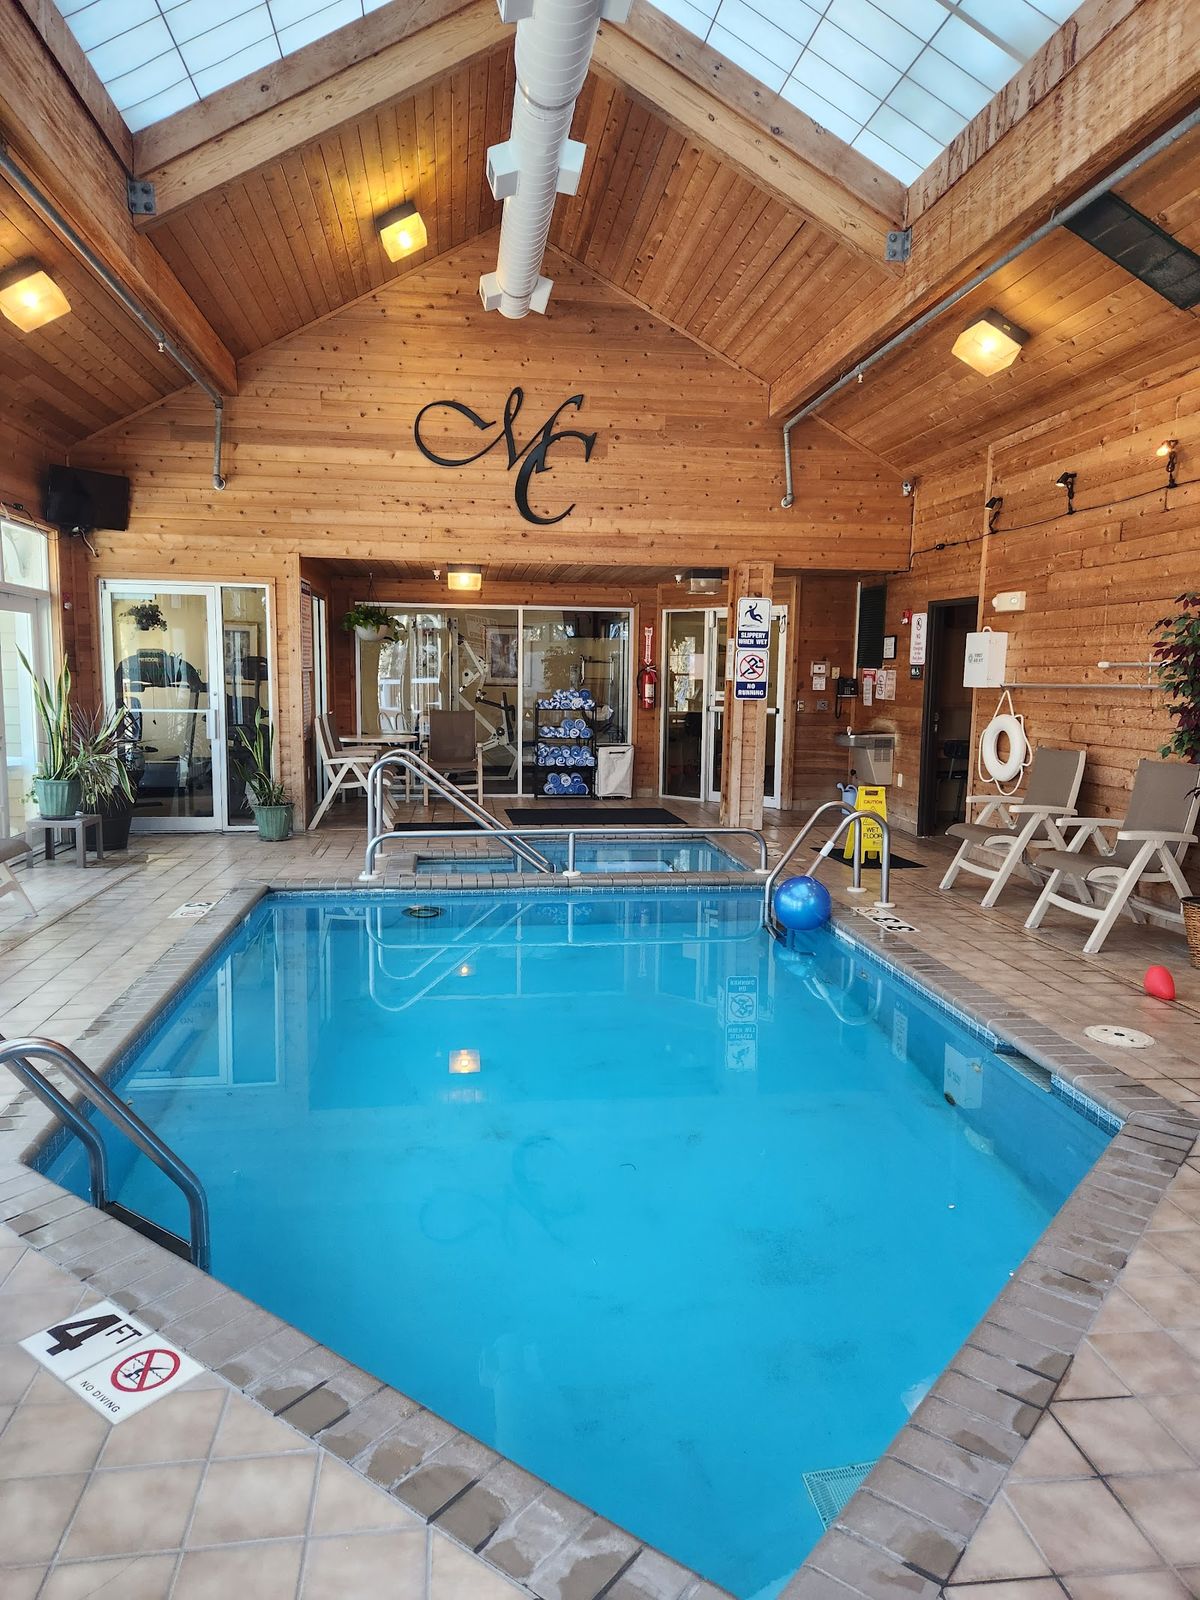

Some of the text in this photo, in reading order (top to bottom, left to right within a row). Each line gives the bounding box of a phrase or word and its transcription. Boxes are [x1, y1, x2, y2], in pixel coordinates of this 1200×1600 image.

[46, 1314, 143, 1356] 4 FT
[80, 1380, 120, 1413] NO DIVING
